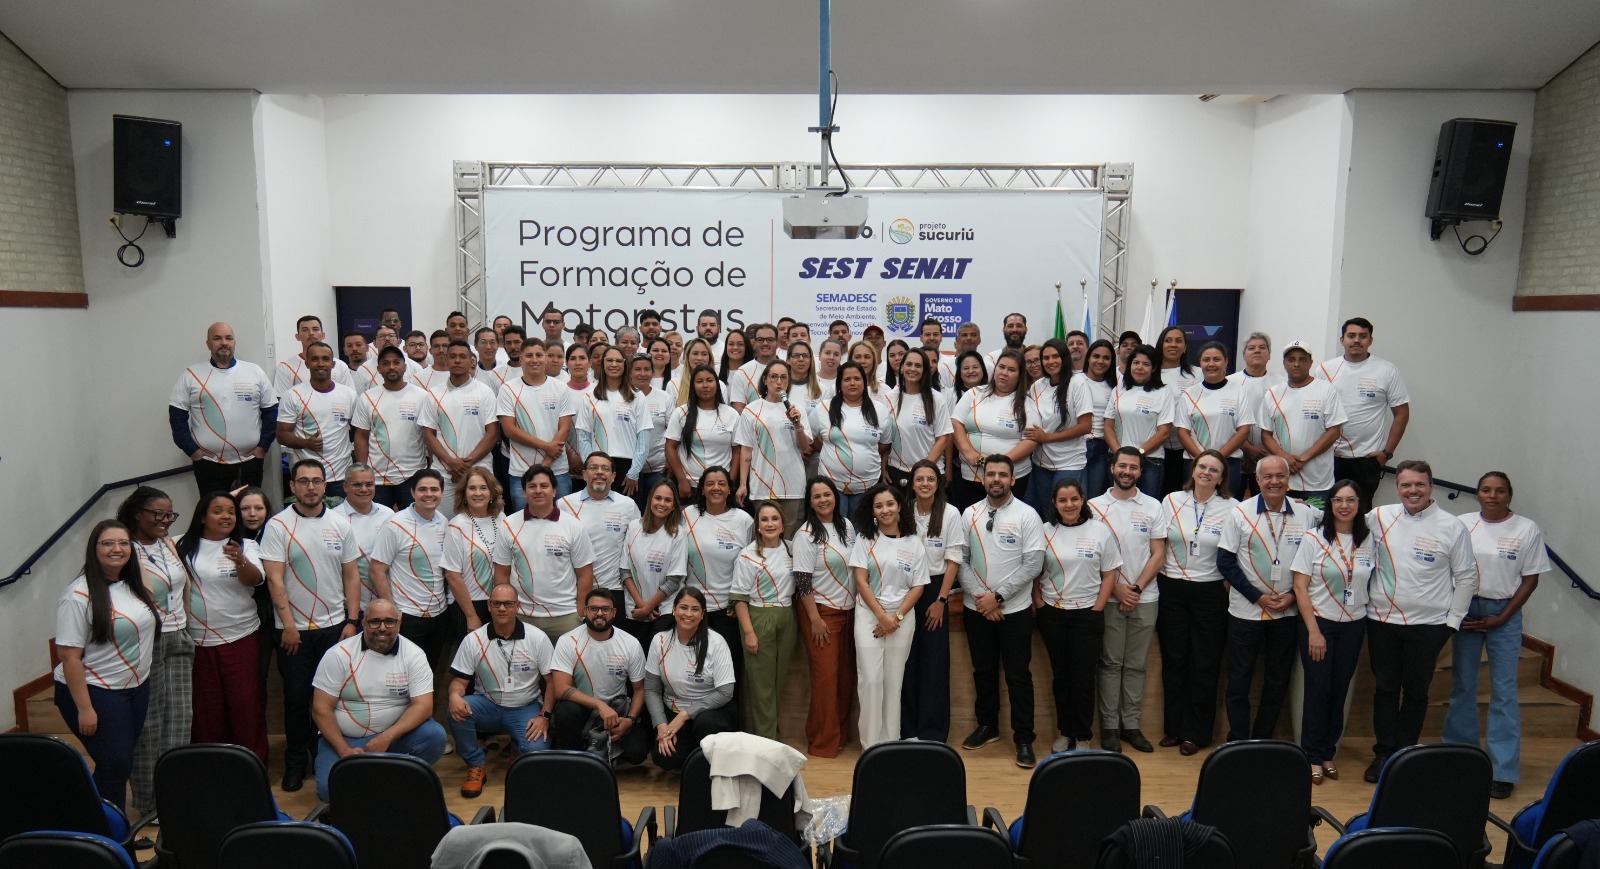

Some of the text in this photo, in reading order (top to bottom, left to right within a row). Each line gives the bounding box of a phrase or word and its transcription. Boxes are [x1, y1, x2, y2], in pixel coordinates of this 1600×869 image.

[519, 219, 745, 252] Programa de
[919, 222, 947, 231] projeto
[919, 228, 974, 241] sucuriú
[520, 260, 747, 295] Formação de
[798, 257, 974, 280] SEST SENAT
[816, 293, 877, 303] SEMADESC
[521, 300, 745, 334] Motorsts
[924, 303, 953, 313] Mato
